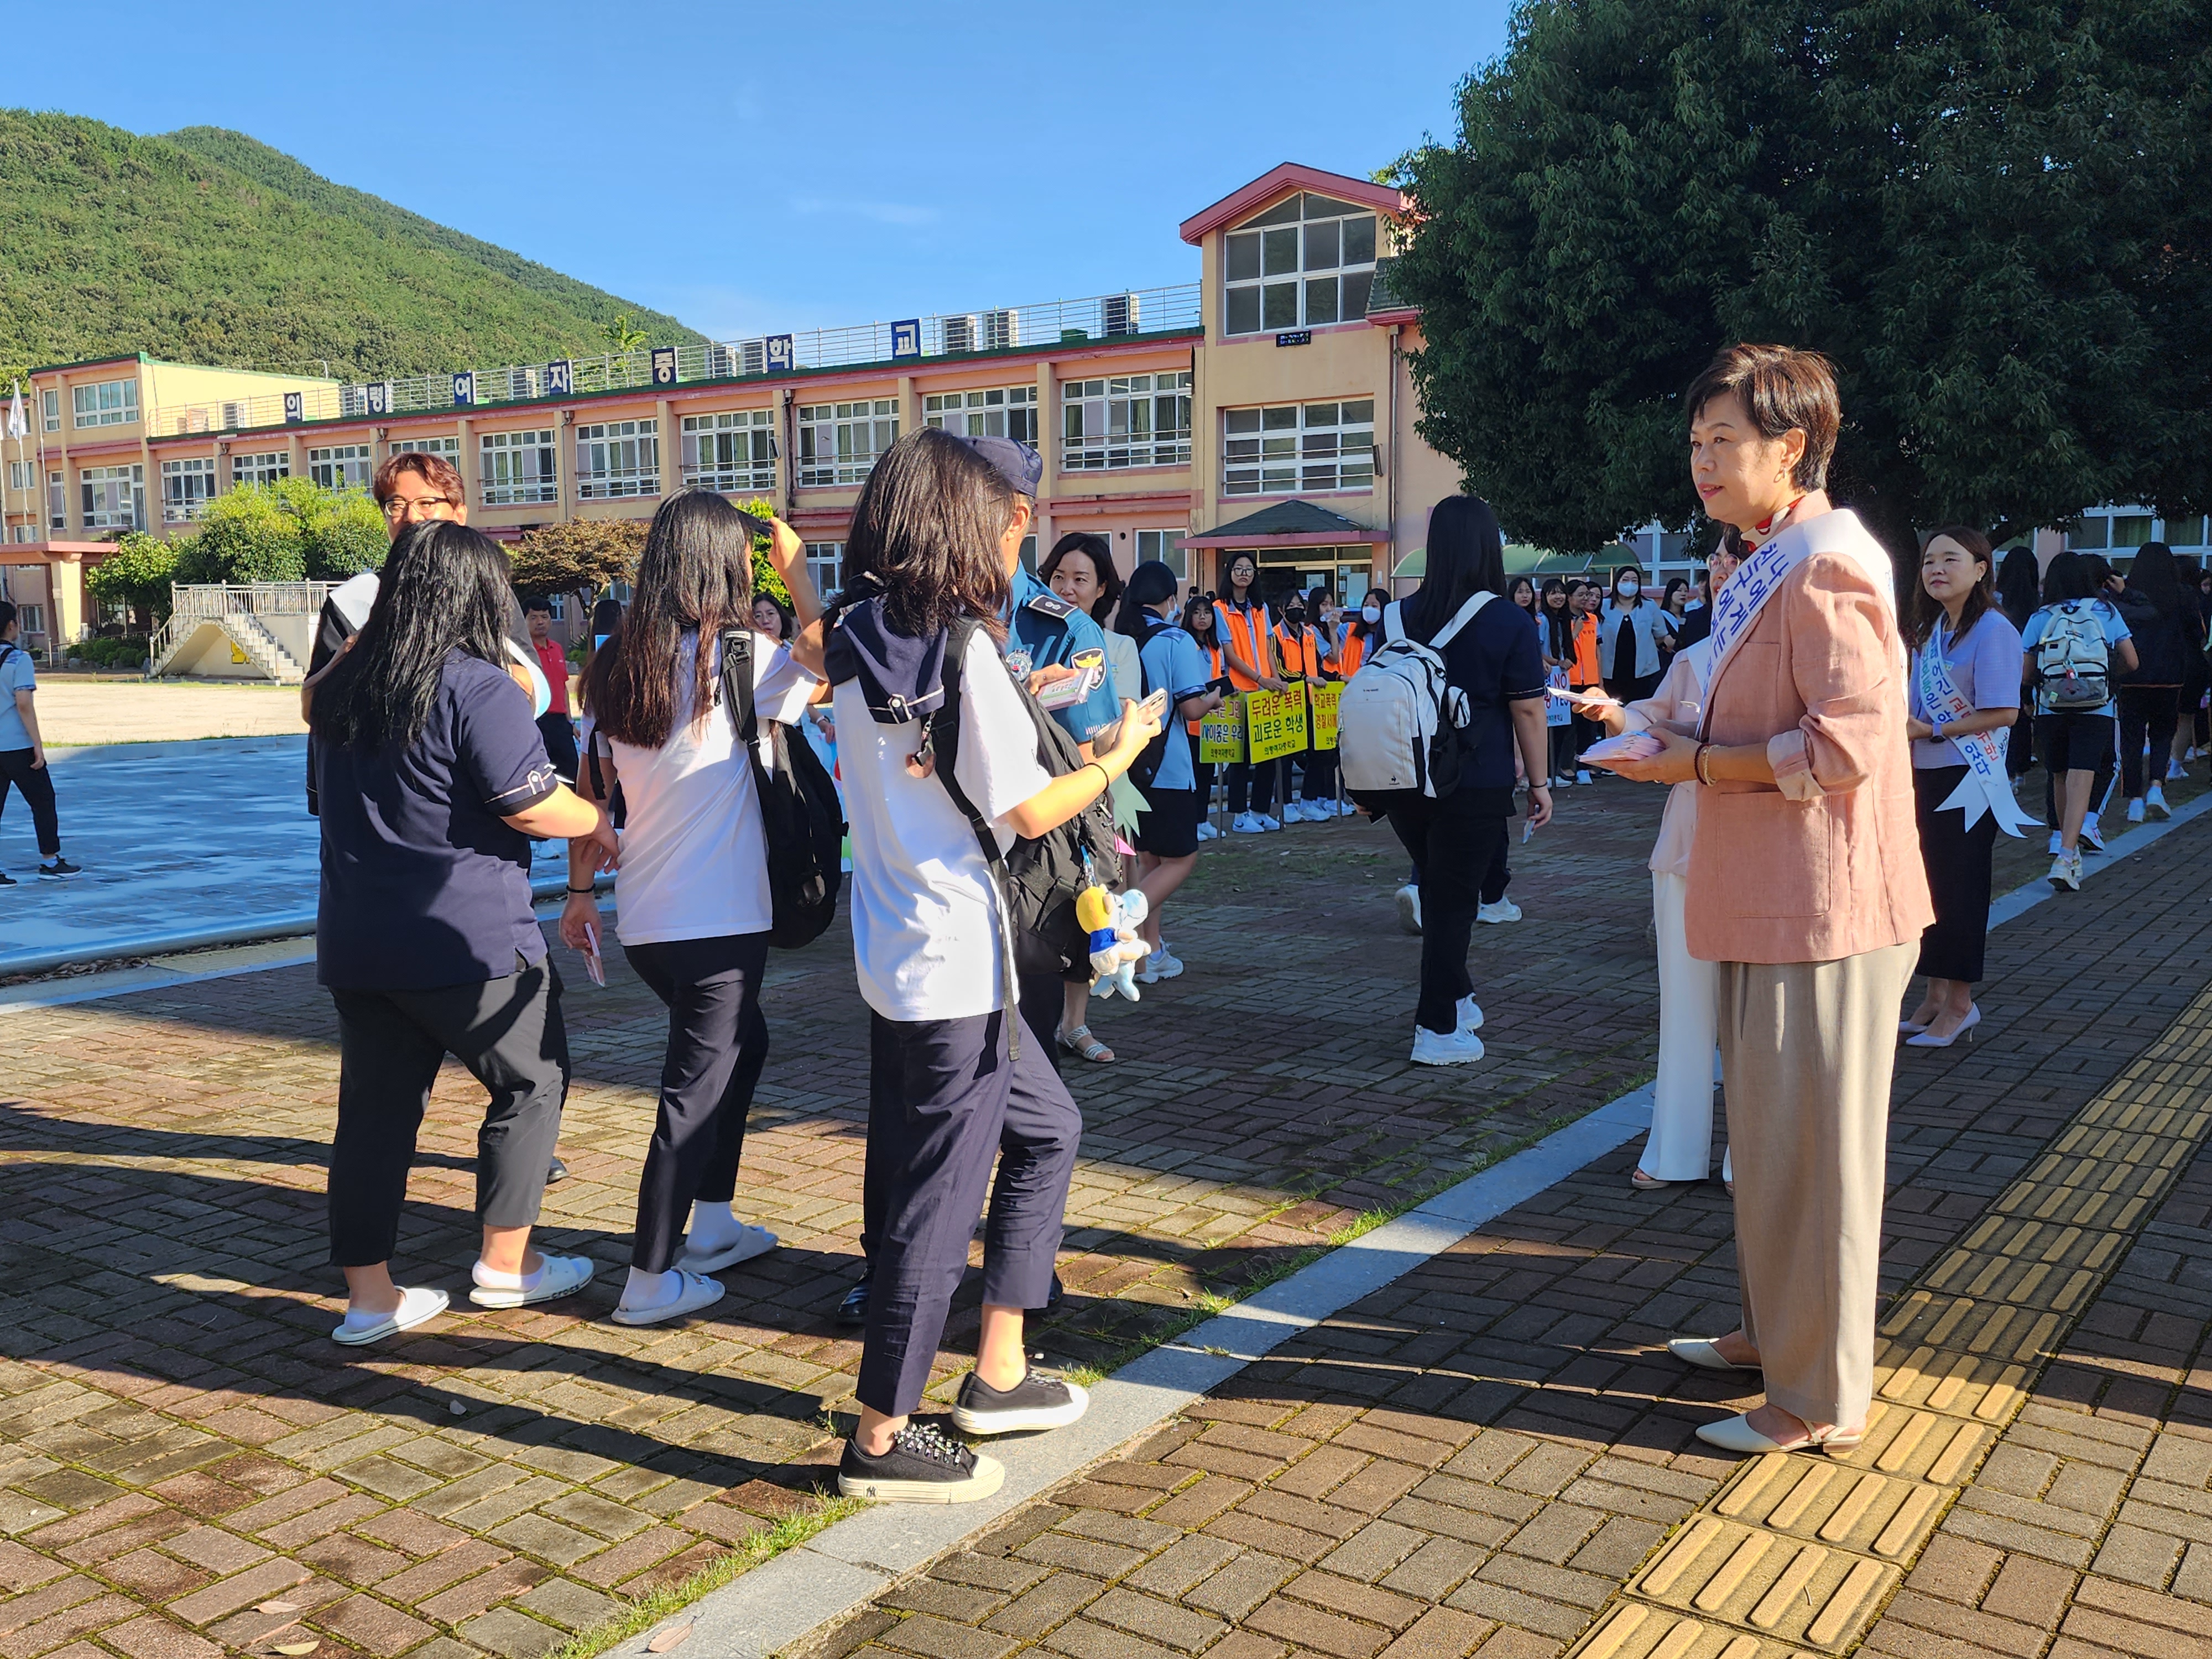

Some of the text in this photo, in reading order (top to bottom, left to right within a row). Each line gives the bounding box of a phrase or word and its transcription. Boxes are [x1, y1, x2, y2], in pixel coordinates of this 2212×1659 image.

[1714, 554, 1789, 659] 나에게는
[1554, 672, 1567, 689] NO
[1932, 661, 1954, 696] 어긴
[1253, 695, 1280, 720] 두려운
[1284, 688, 1302, 712] 폭력
[1254, 713, 1303, 743] 괴로운 학생
[1965, 742, 1991, 775] 있다
